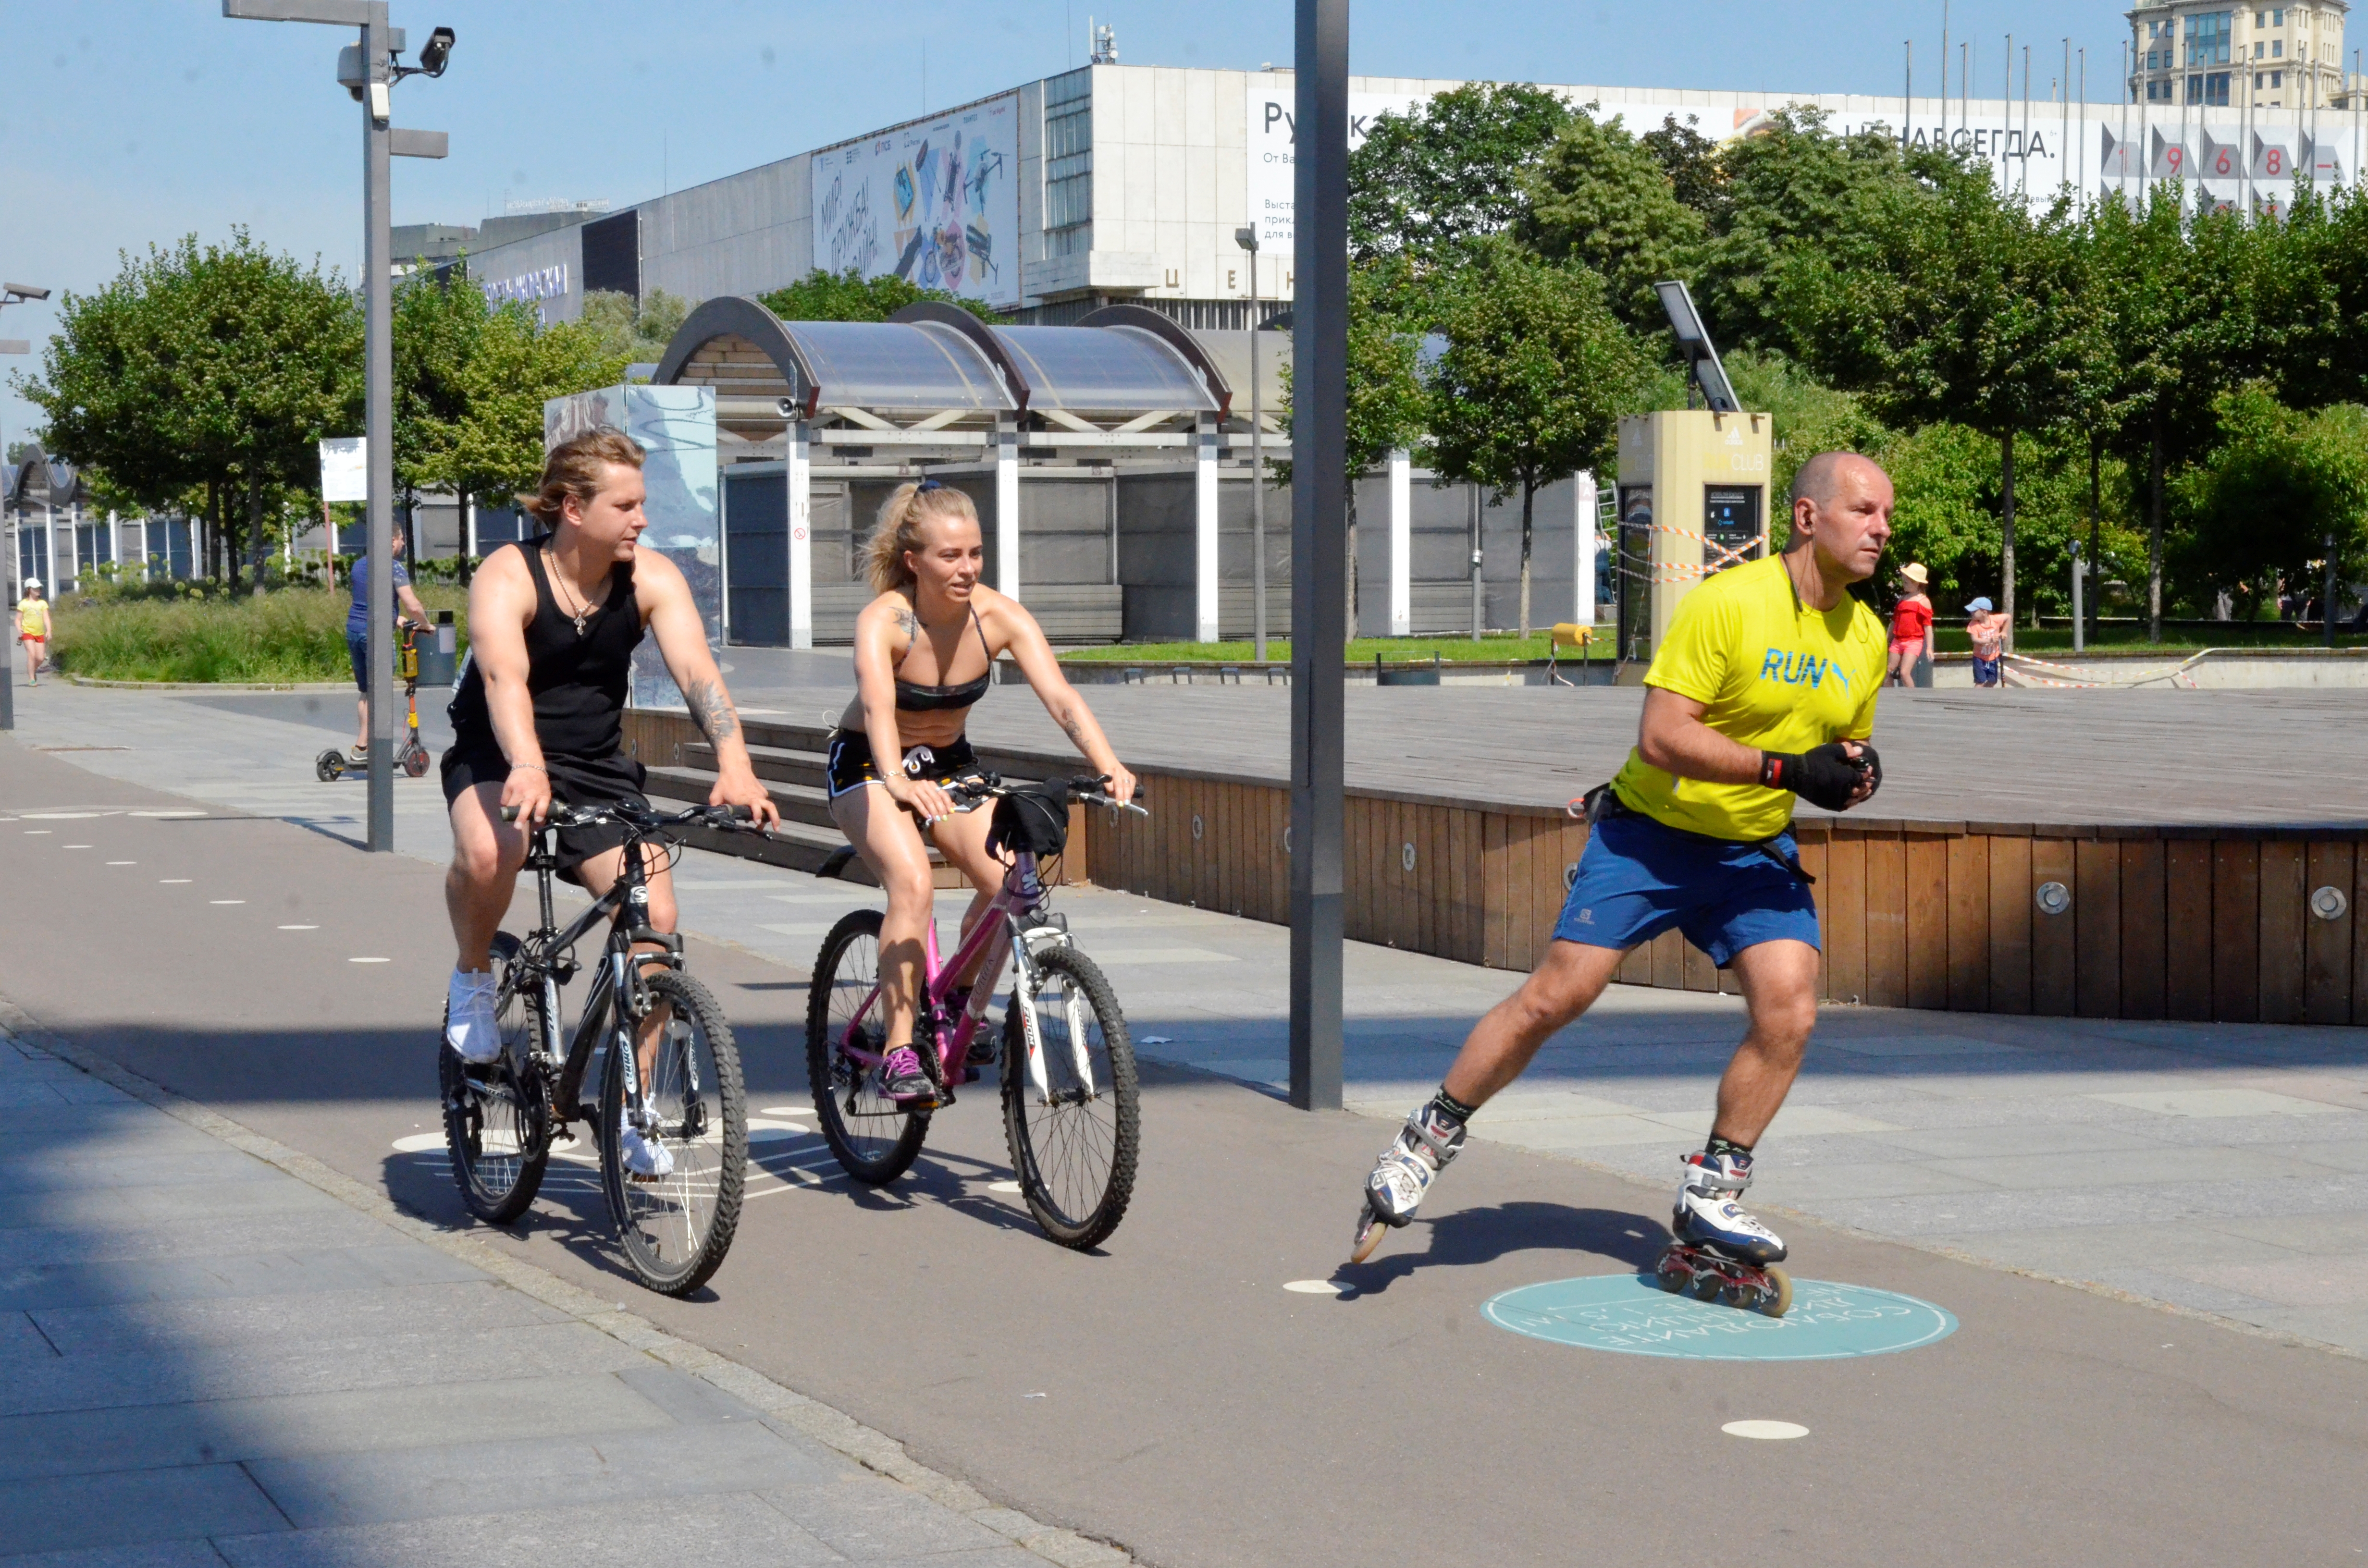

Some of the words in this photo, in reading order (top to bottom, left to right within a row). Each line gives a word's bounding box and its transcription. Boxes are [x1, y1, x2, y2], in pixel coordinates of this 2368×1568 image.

[1263, 152, 1279, 163] От
[821, 169, 842, 242] МИР!
[1264, 231, 1283, 239] для
[1731, 454, 1764, 470] CLUB
[1583, 487, 1591, 497] A
[1760, 648, 1828, 689] RUN
[1023, 1006, 1035, 1046] ZOOM
[1408, 1162, 1426, 1179] FILA
